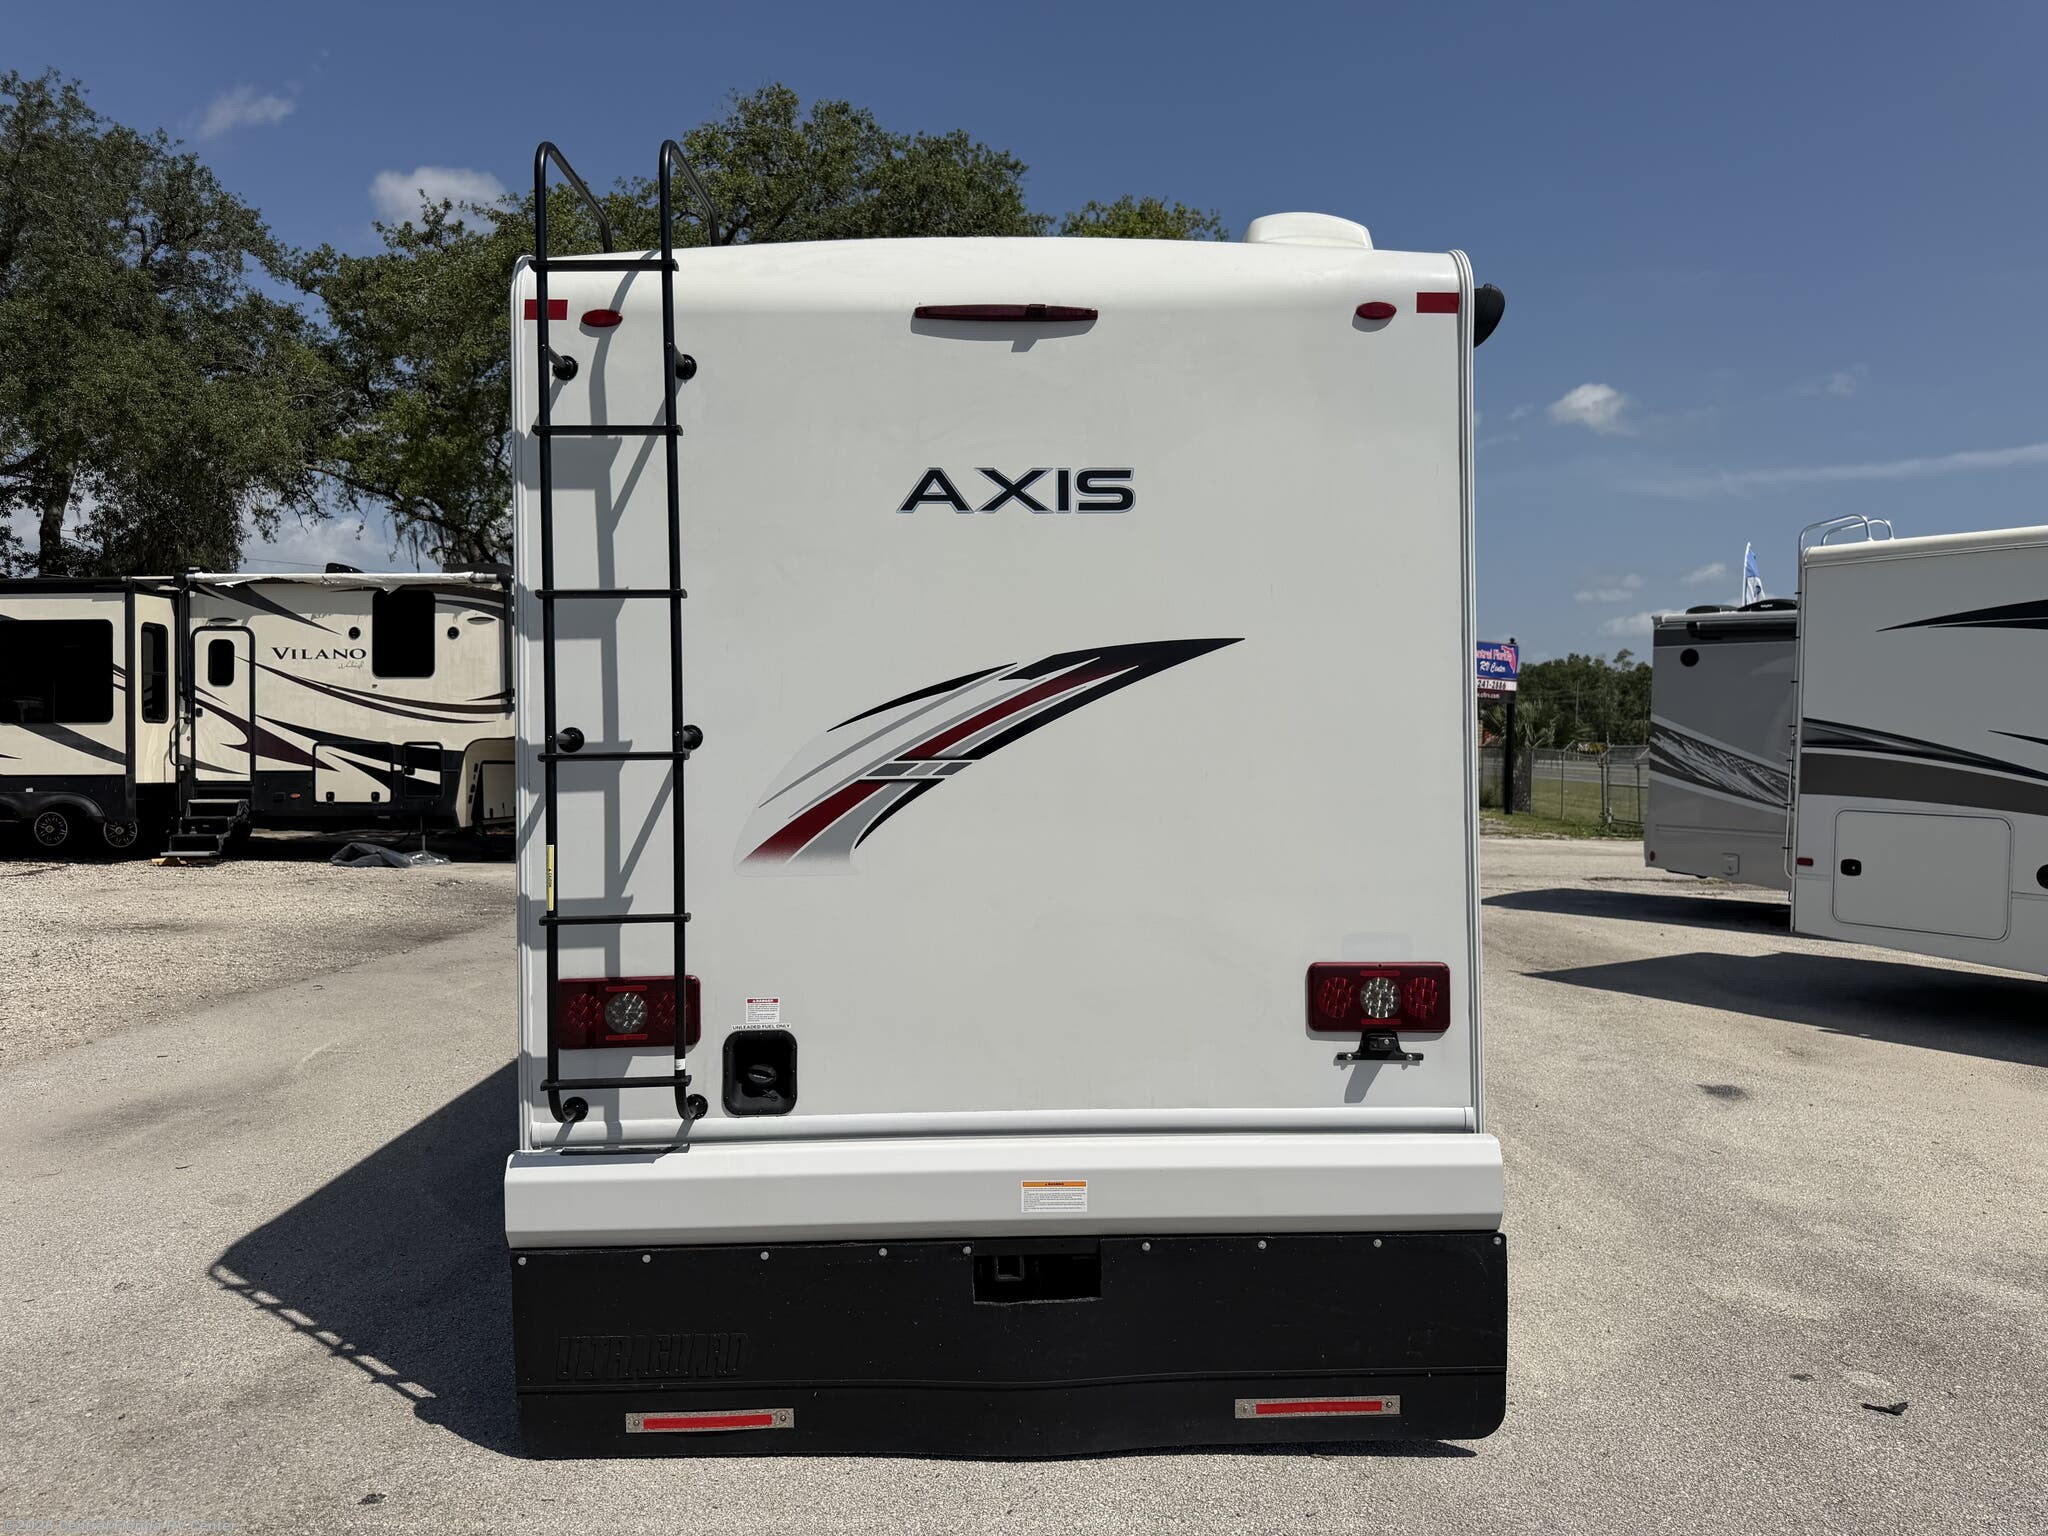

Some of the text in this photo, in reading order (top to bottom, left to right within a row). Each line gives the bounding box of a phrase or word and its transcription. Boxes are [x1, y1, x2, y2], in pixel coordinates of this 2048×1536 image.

[896, 467, 1136, 514] AXIS
[271, 647, 367, 660] VILANO
[1480, 660, 1490, 671] RV
